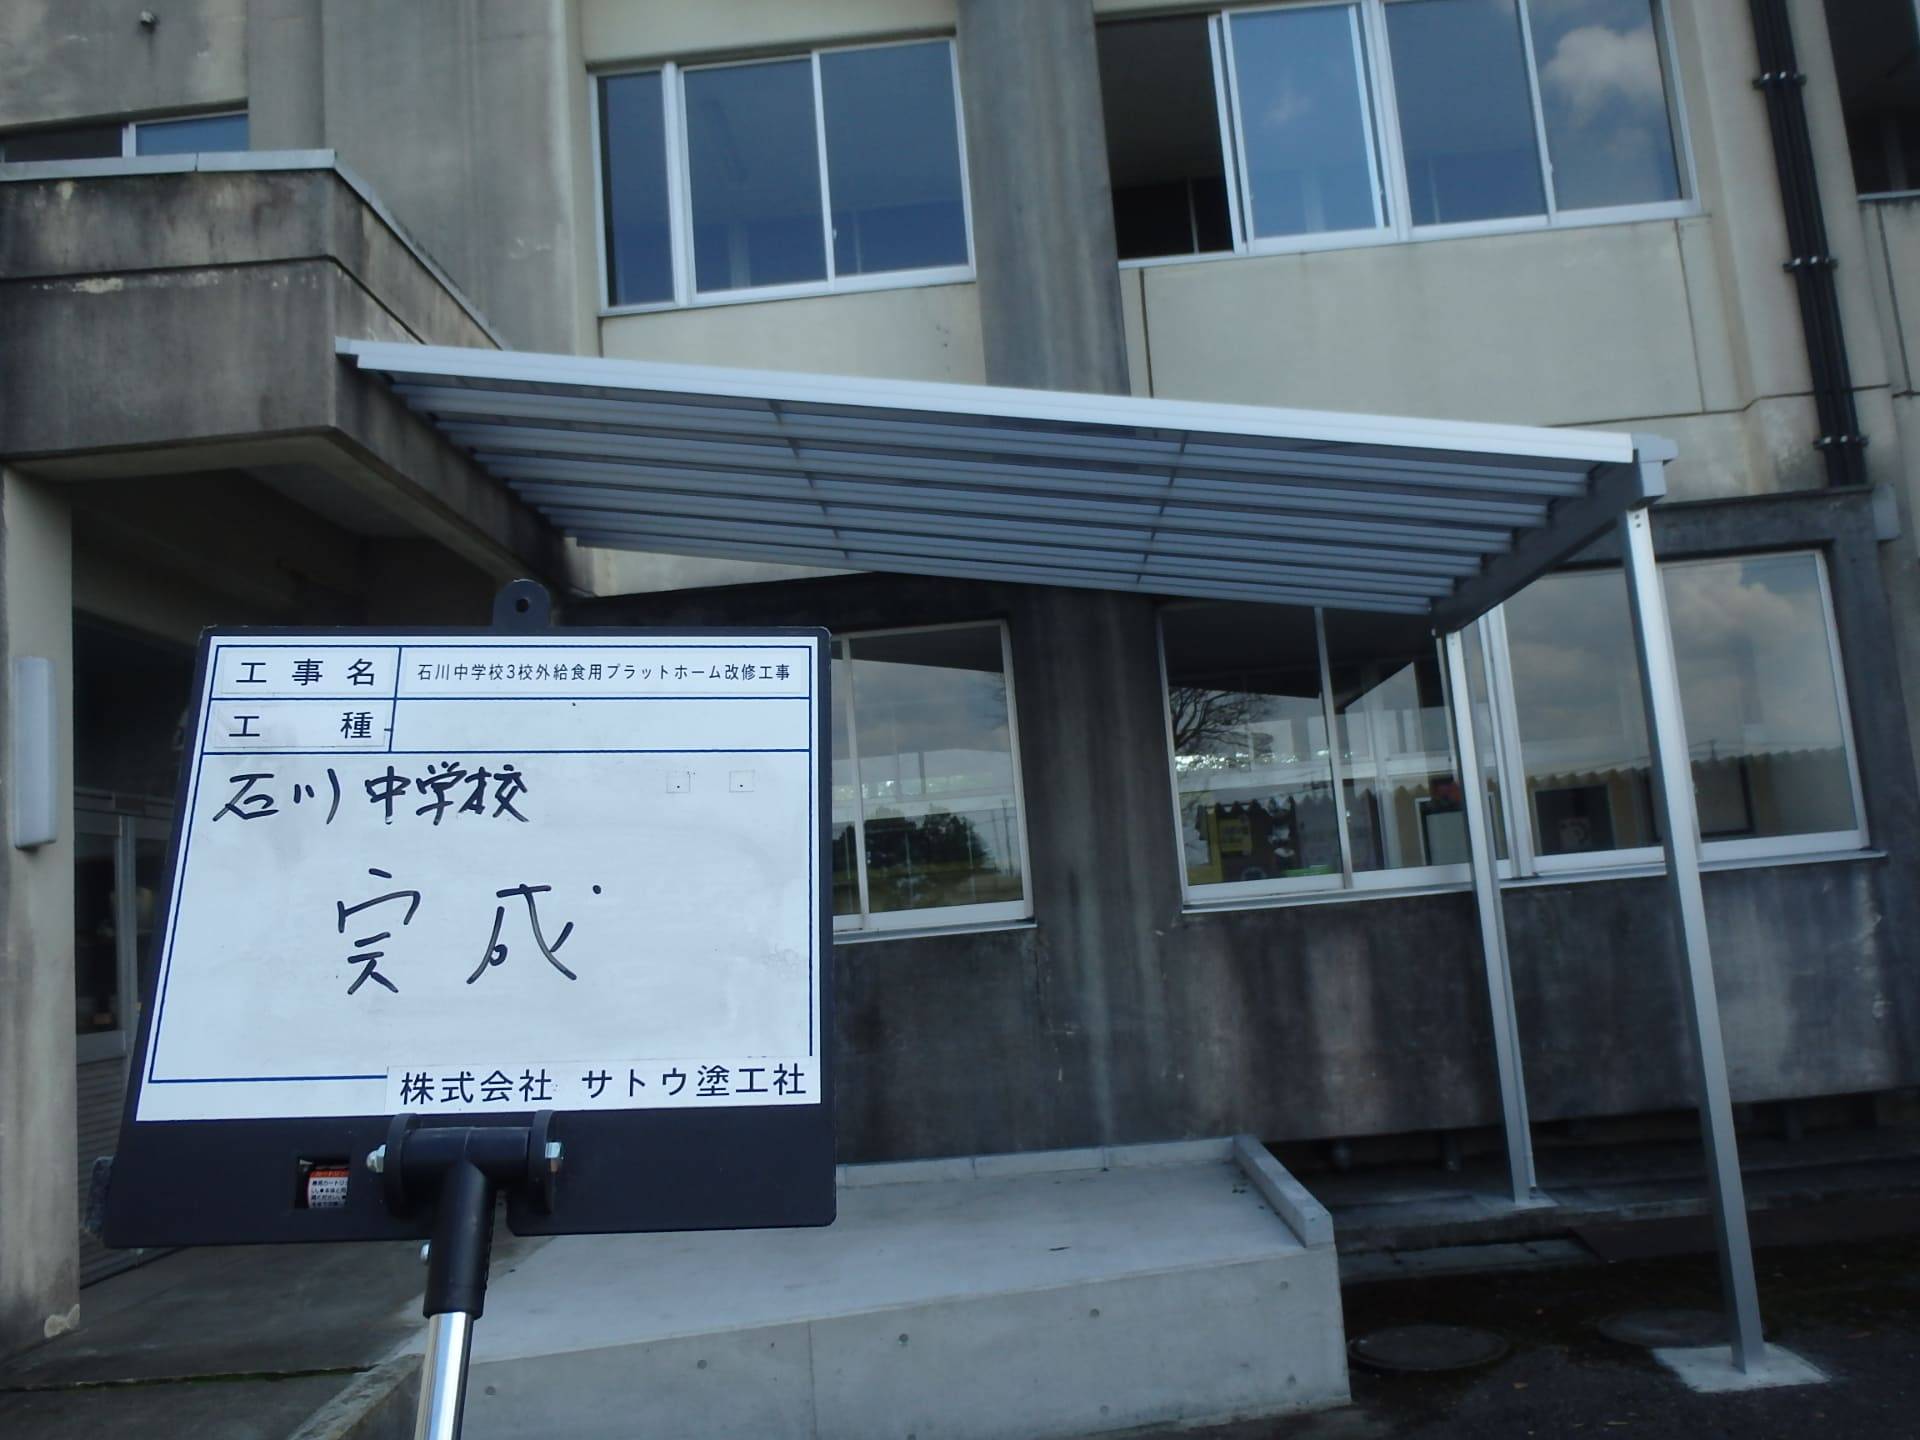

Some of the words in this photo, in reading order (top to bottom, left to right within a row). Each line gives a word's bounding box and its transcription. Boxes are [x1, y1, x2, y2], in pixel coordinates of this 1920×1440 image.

[233, 657, 376, 687] 工事名
[415, 662, 792, 682] 石川中学校3校外給食用プラットホーム改修工事
[212, 760, 530, 826] 石川中学校
[336, 867, 603, 996] 完成
[399, 1069, 554, 1106] 株式会社
[580, 1062, 808, 1100] サトウ塗工社
